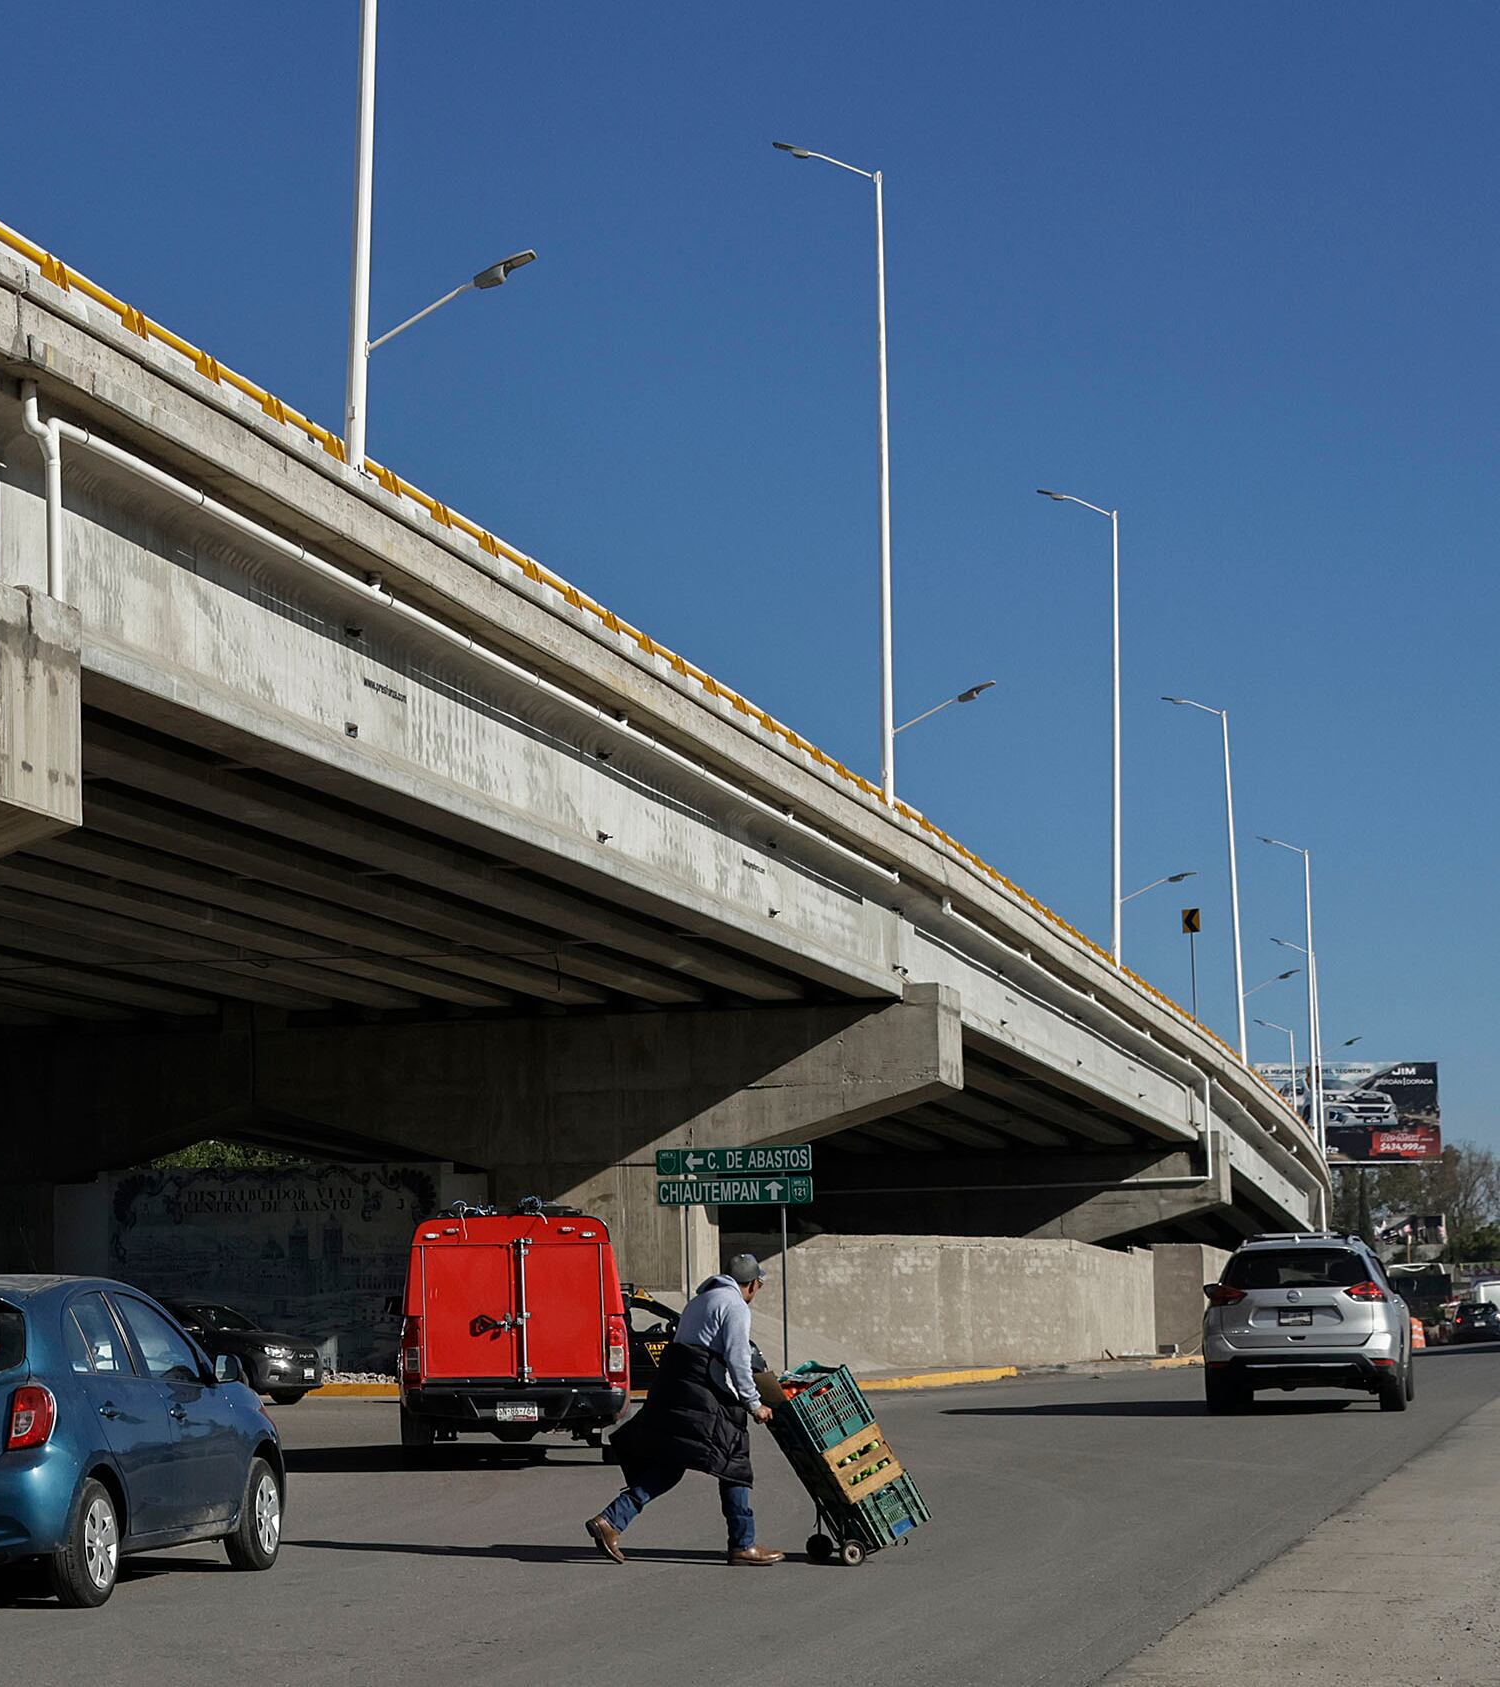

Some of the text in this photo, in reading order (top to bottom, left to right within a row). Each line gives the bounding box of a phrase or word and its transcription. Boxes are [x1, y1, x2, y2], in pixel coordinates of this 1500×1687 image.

[1391, 1067, 1416, 1076] JIM
[707, 1149, 808, 1170] C. DE ABASTOS
[659, 1181, 760, 1204] CHIAUTEMPAN
[793, 1187, 806, 1197] 121
[183, 1199, 351, 1214] CENTRAL DE ABASTO
